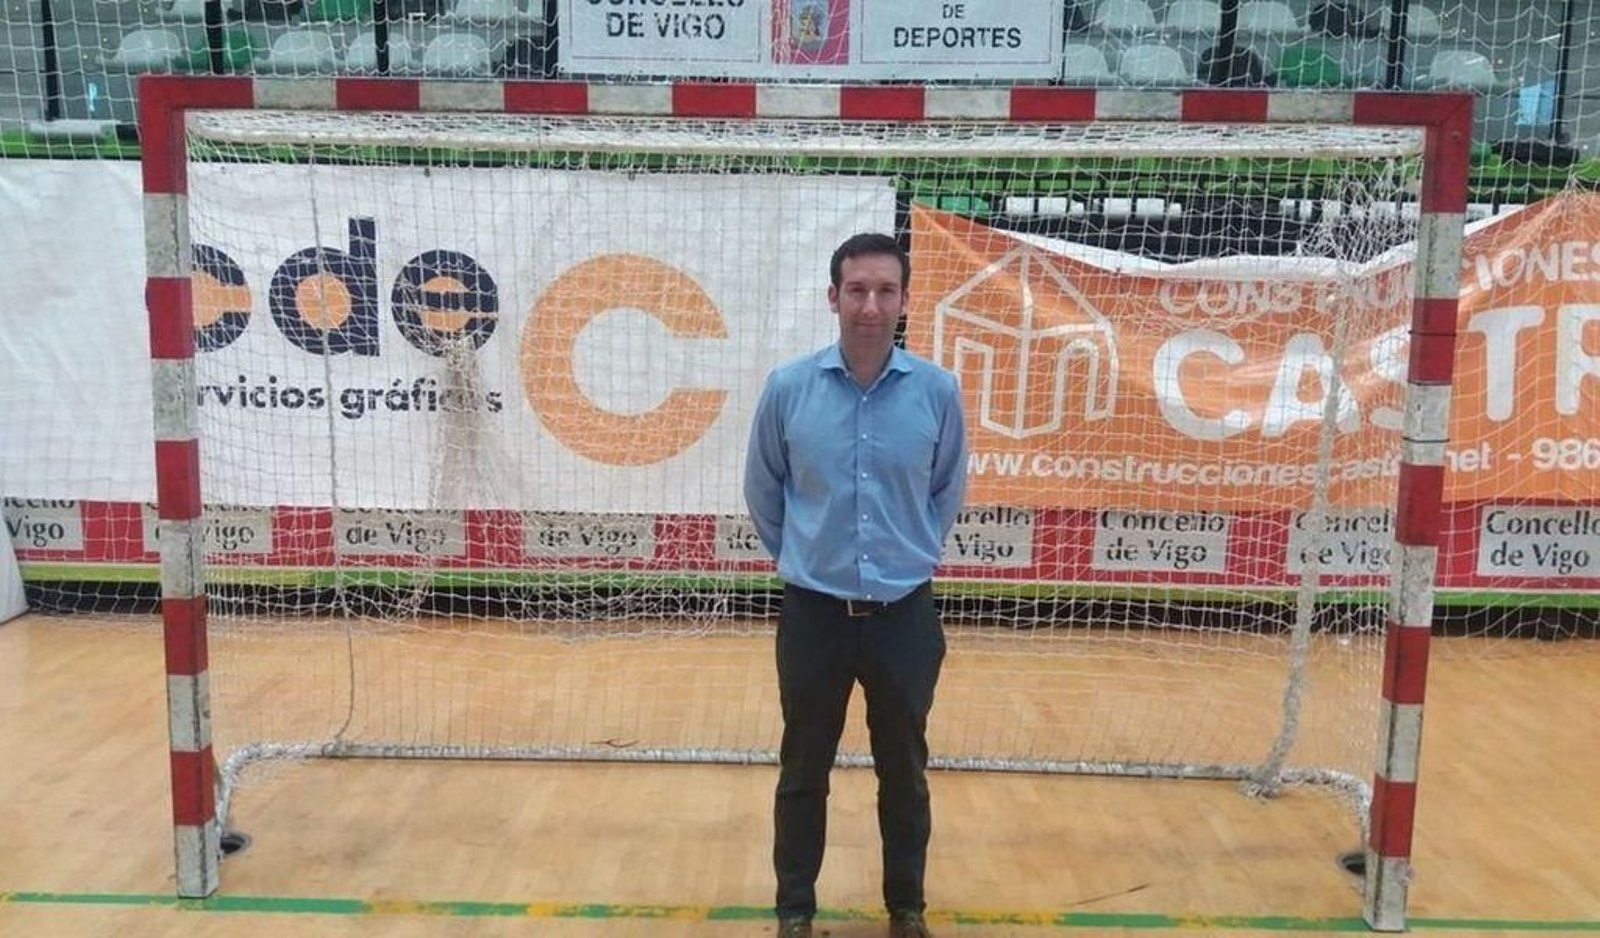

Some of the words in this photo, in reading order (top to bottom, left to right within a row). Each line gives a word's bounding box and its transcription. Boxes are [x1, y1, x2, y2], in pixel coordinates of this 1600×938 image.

[606, 12, 645, 38] DE
[654, 13, 726, 39] VIGO
[942, 4, 965, 19] DE
[893, 26, 1022, 49] DEPORTES
[197, 374, 326, 410] rvicios
[340, 377, 503, 420] gráfics
[5, 514, 65, 548] Vigo
[346, 520, 378, 546] de
[385, 520, 447, 554] Vigo
[1106, 536, 1139, 562] de
[1148, 537, 1208, 570] Vigo
[1489, 541, 1524, 567] de
[1532, 542, 1590, 575] Vigo
